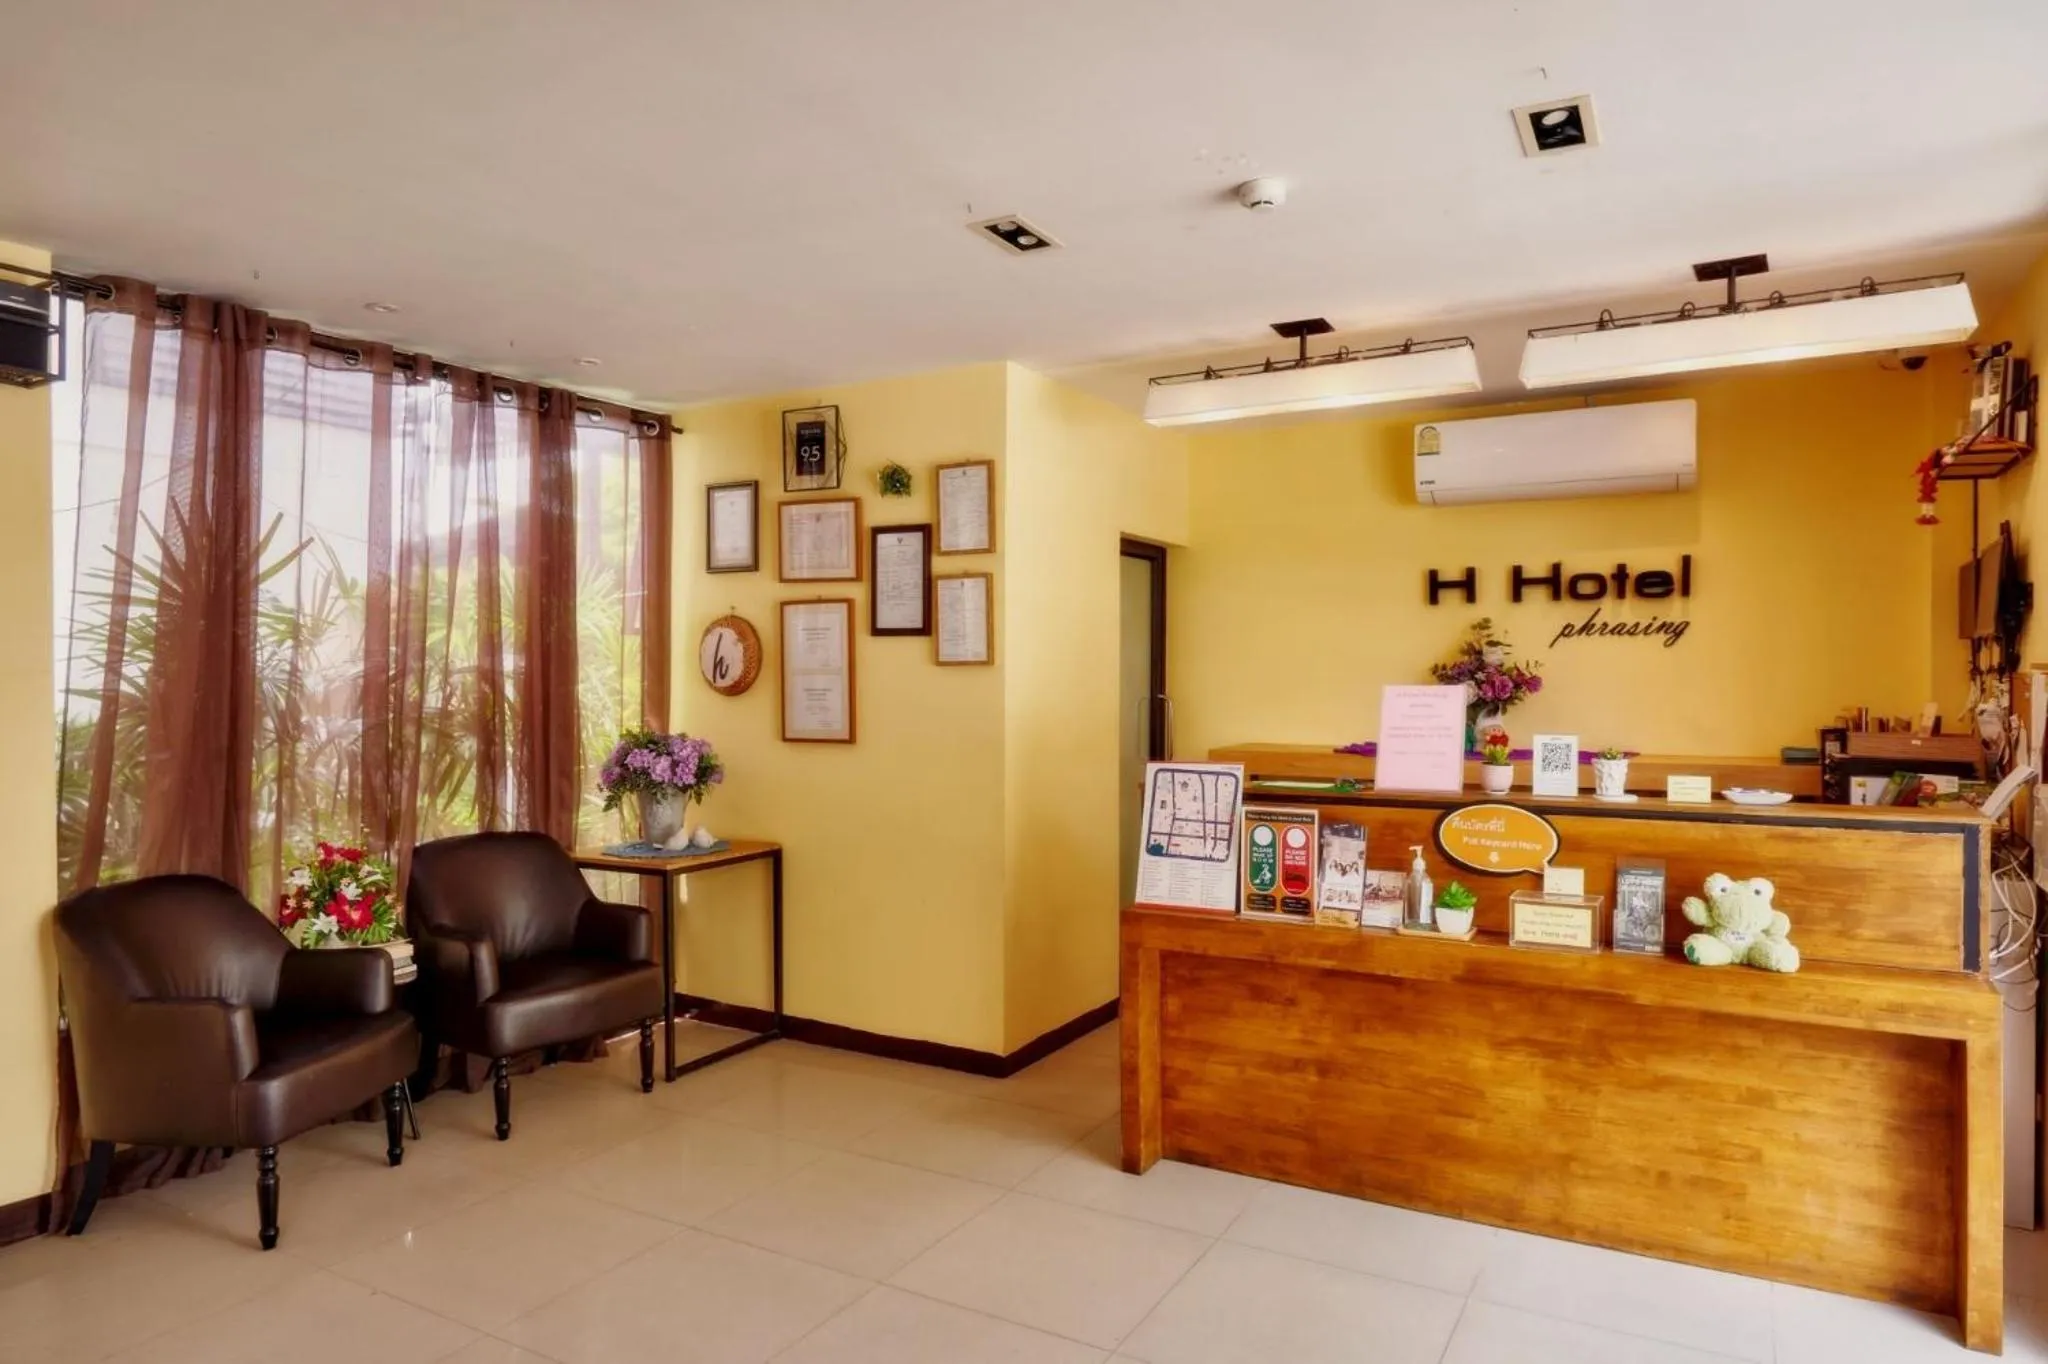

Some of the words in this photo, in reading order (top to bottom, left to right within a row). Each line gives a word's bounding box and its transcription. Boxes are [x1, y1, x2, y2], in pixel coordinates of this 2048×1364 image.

[1428, 566, 1476, 605] H
[1511, 554, 1692, 603] Hotel
[1548, 607, 1691, 649] phrasing
